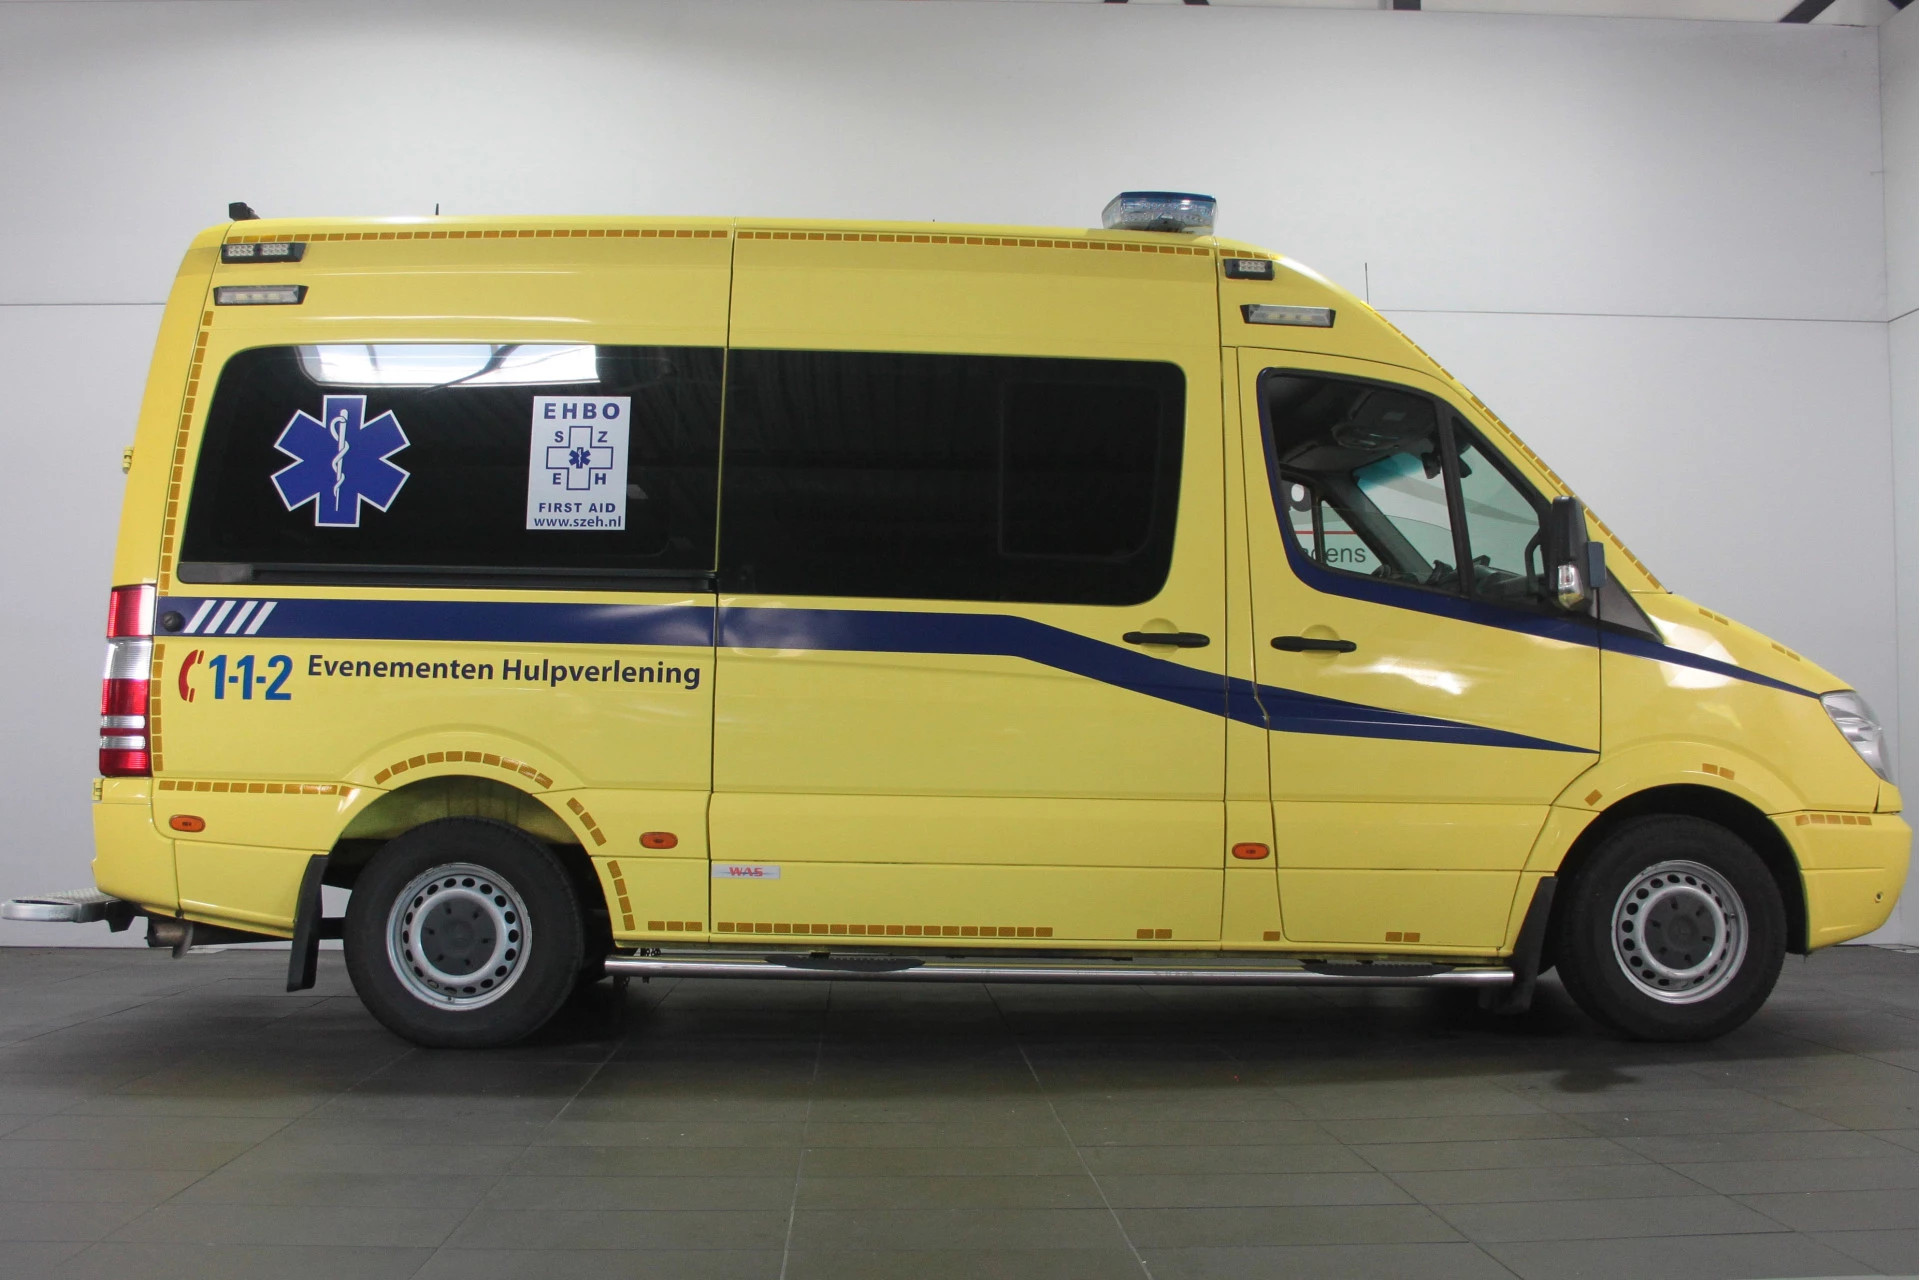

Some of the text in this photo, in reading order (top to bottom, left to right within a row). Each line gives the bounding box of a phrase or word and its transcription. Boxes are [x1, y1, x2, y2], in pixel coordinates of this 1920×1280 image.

[544, 403, 620, 419] EHBO
[554, 431, 608, 443] S Z
[552, 473, 607, 485] E H
[538, 503, 616, 513] FIRST AID
[534, 516, 622, 527] www.szeh.nl
[209, 654, 294, 700] 1-1-2
[308, 654, 701, 690] Evenementen Hulpverlening
[729, 867, 763, 877] WAS
